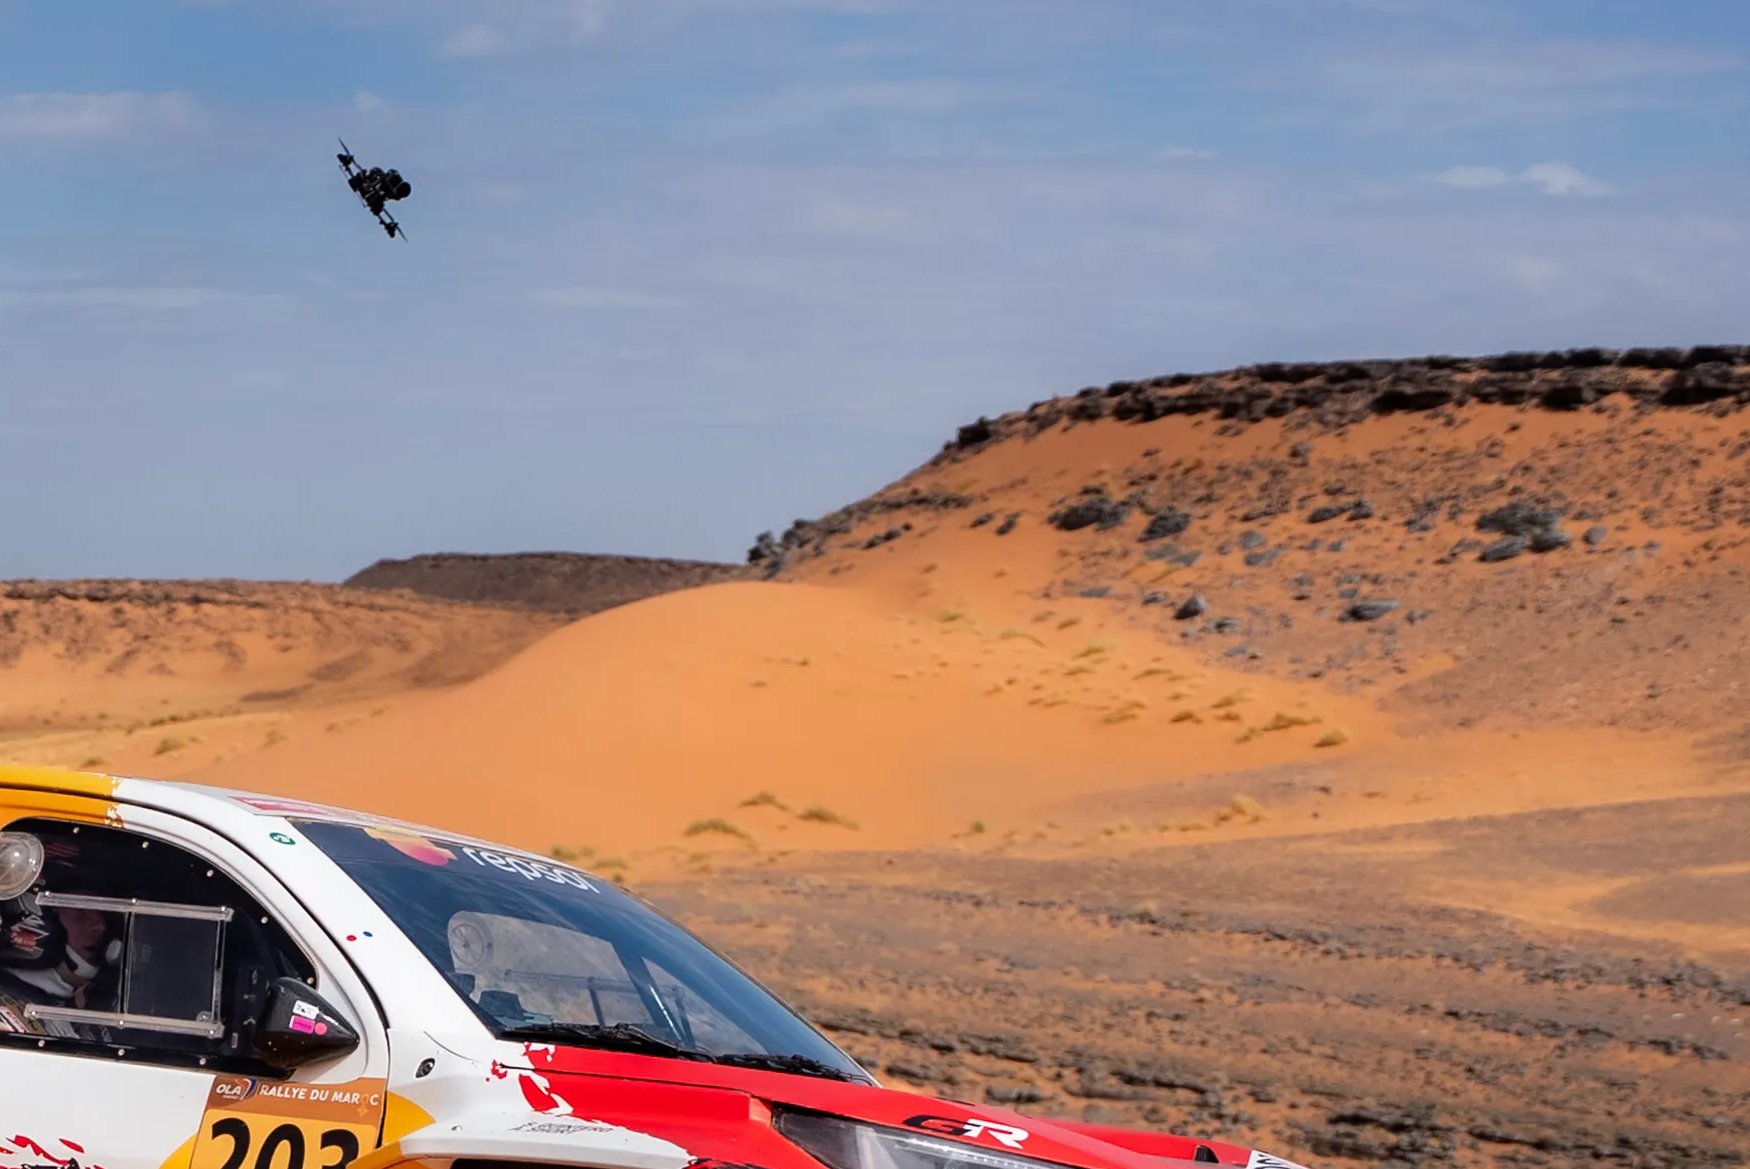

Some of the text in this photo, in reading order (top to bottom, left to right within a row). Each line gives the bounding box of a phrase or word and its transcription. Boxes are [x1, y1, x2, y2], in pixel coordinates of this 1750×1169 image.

[462, 846, 601, 894] repsol
[216, 1083, 241, 1095] OLA
[259, 1085, 379, 1106] RALLYE DU MAROC
[902, 1114, 1029, 1149] GR
